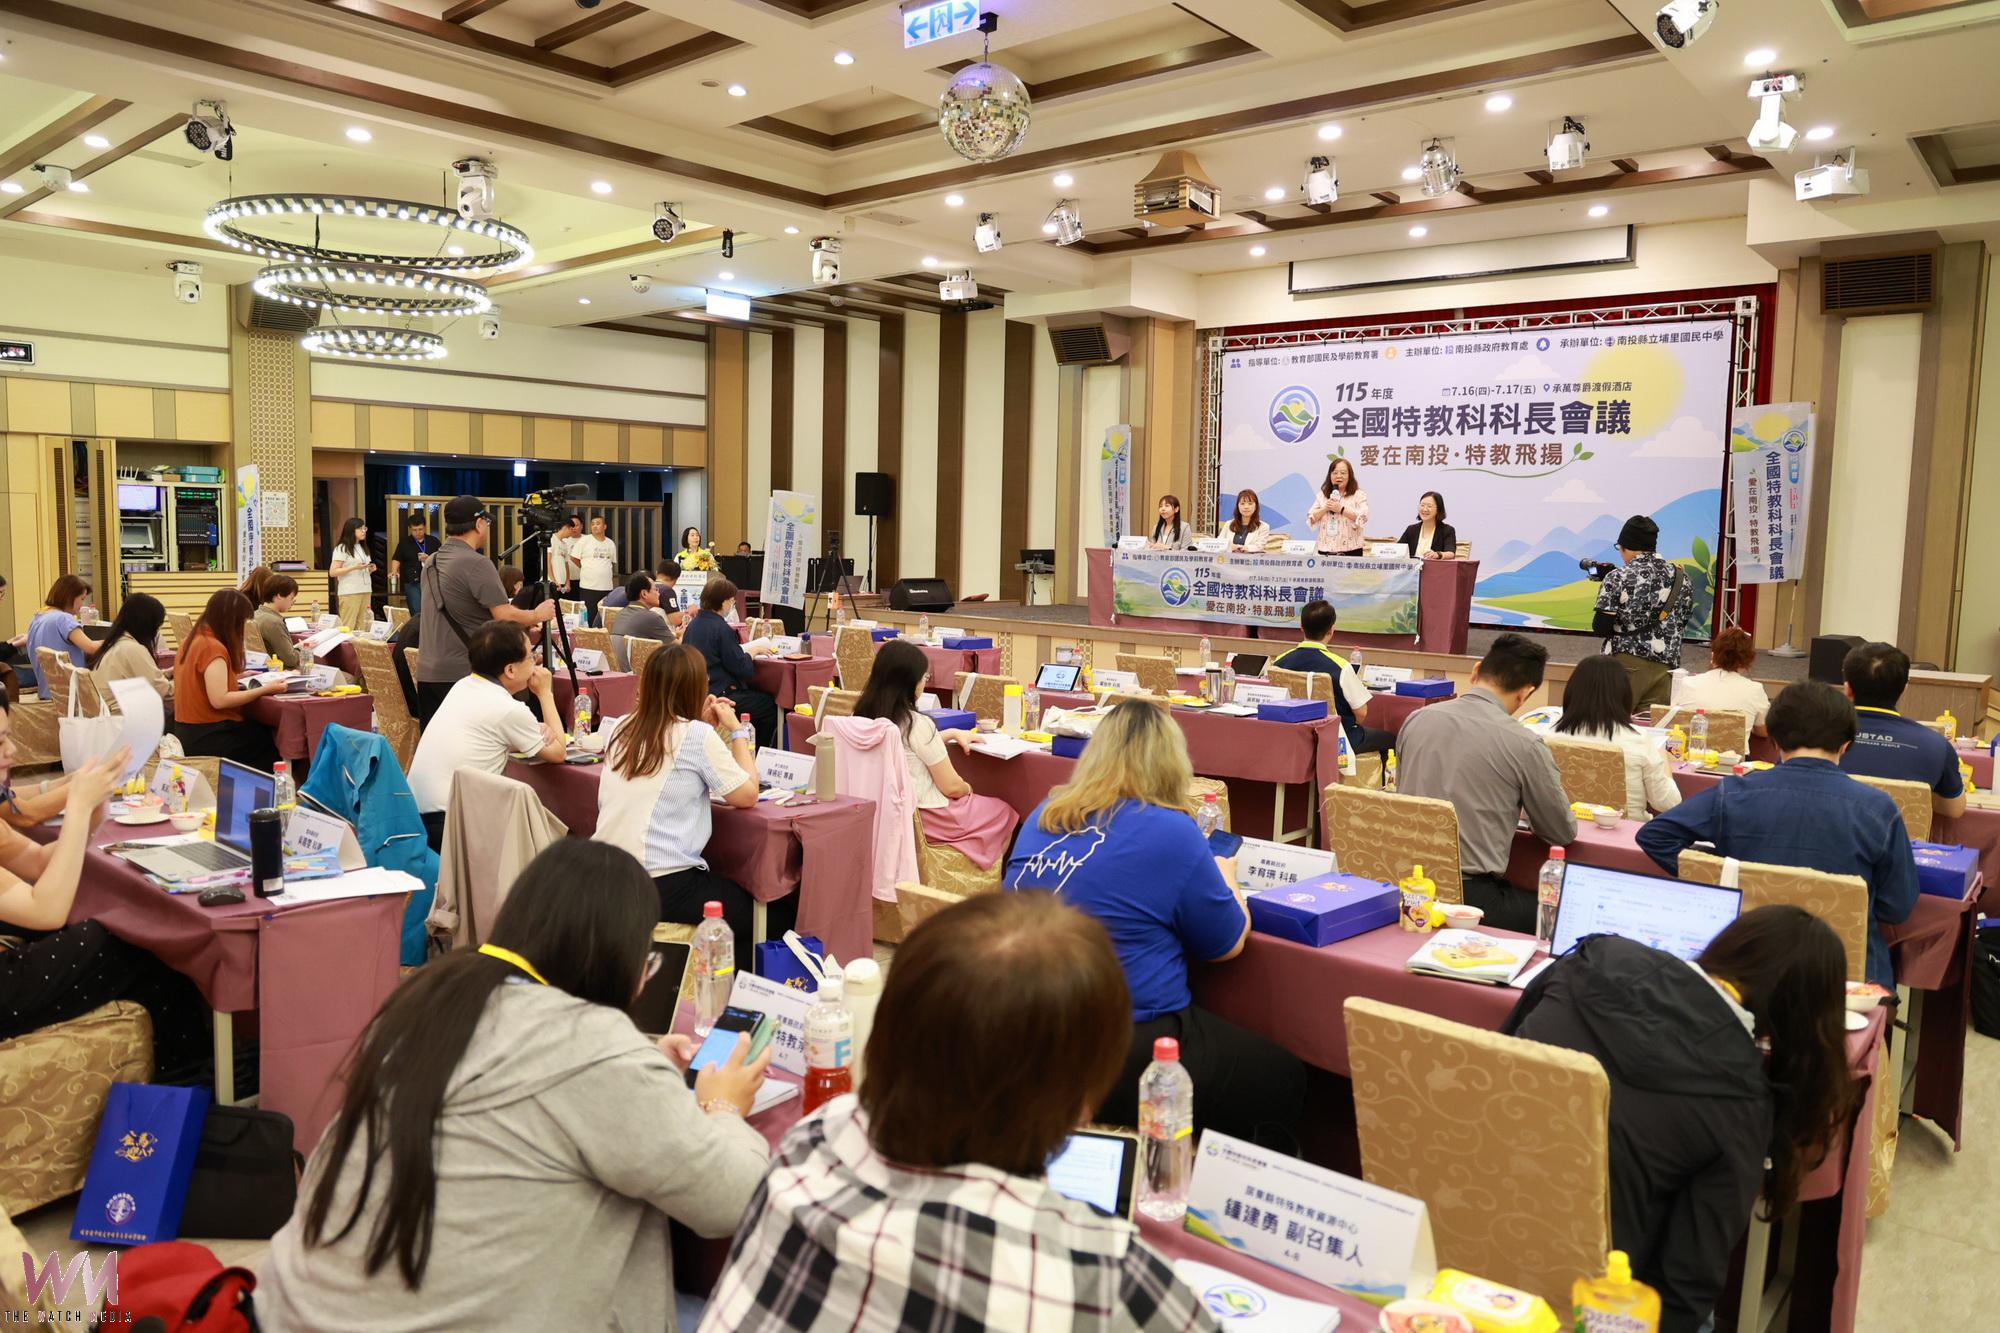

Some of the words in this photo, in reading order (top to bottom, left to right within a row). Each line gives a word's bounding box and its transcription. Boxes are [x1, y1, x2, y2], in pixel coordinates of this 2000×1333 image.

[1405, 346, 1443, 358] 主辦單位:
[1455, 340, 1529, 355] 南投縣政府教育處
[1559, 337, 1603, 349] 承辦單位:
[1617, 330, 1724, 346] 南投縣立埔里國民中學
[1291, 349, 1379, 365] 教育部國民及學前教育署
[1335, 381, 1369, 402] 115
[1371, 387, 1394, 400] 年度
[1552, 381, 1632, 393] 承萬尊爵渡假酒店
[1331, 399, 1632, 438] 全國特教科科長會議
[1765, 450, 1785, 580] 全國特教科科長會議
[1194, 567, 1210, 578] 115
[1193, 580, 1324, 603] 全國特教科科長會議
[1285, 1220, 1363, 1268] 副召集人
